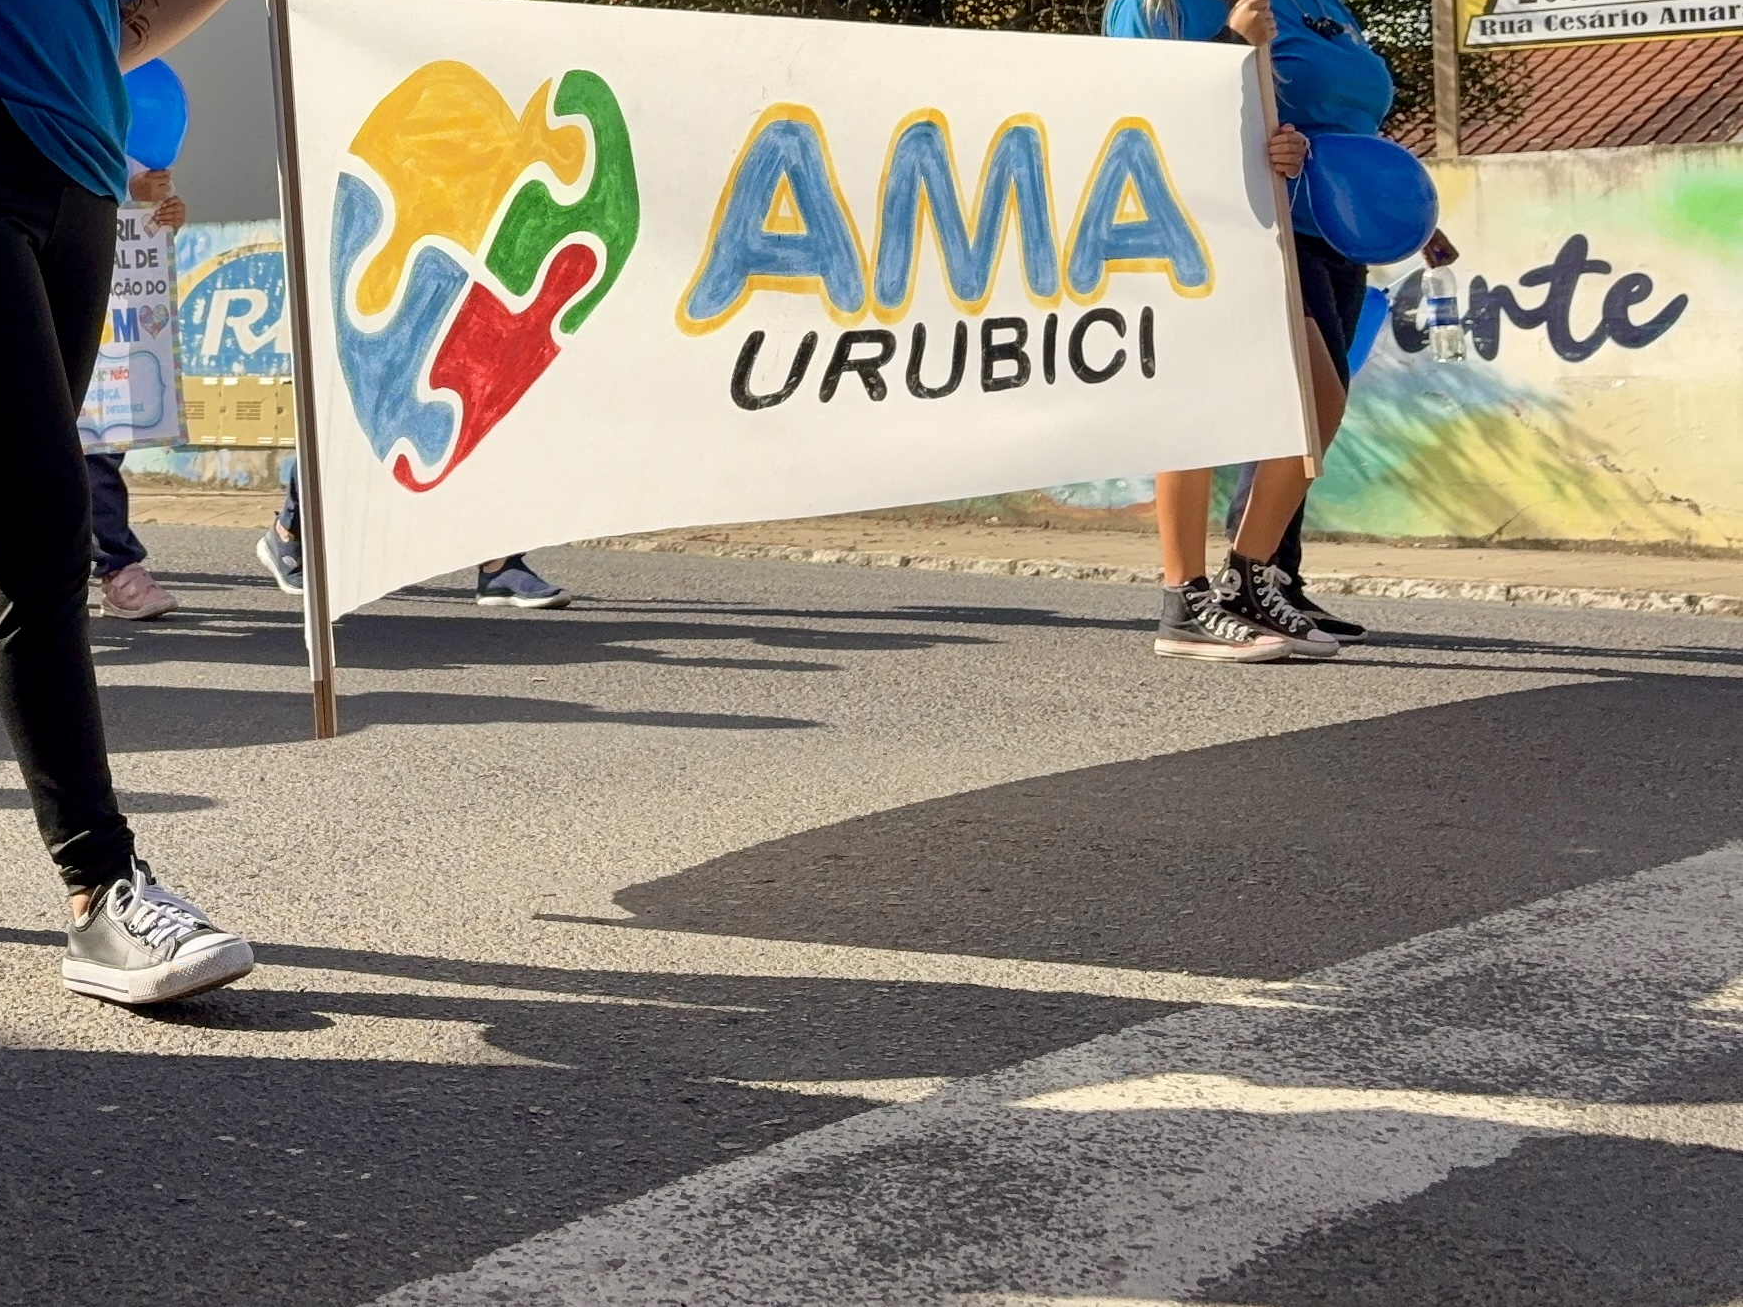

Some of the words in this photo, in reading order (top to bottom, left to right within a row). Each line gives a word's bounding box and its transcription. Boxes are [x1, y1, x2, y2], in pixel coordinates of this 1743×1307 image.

[1480, 18, 1533, 36] Rua
[1544, 10, 1648, 31] Cesário
[1659, 4, 1743, 25] Amar
[675, 103, 1212, 336] AMA
[135, 248, 159, 269] DE
[110, 278, 143, 299] ÇÃO
[145, 280, 167, 296] DO
[730, 306, 1154, 411] URUBICI
[110, 366, 130, 382] NÃO
